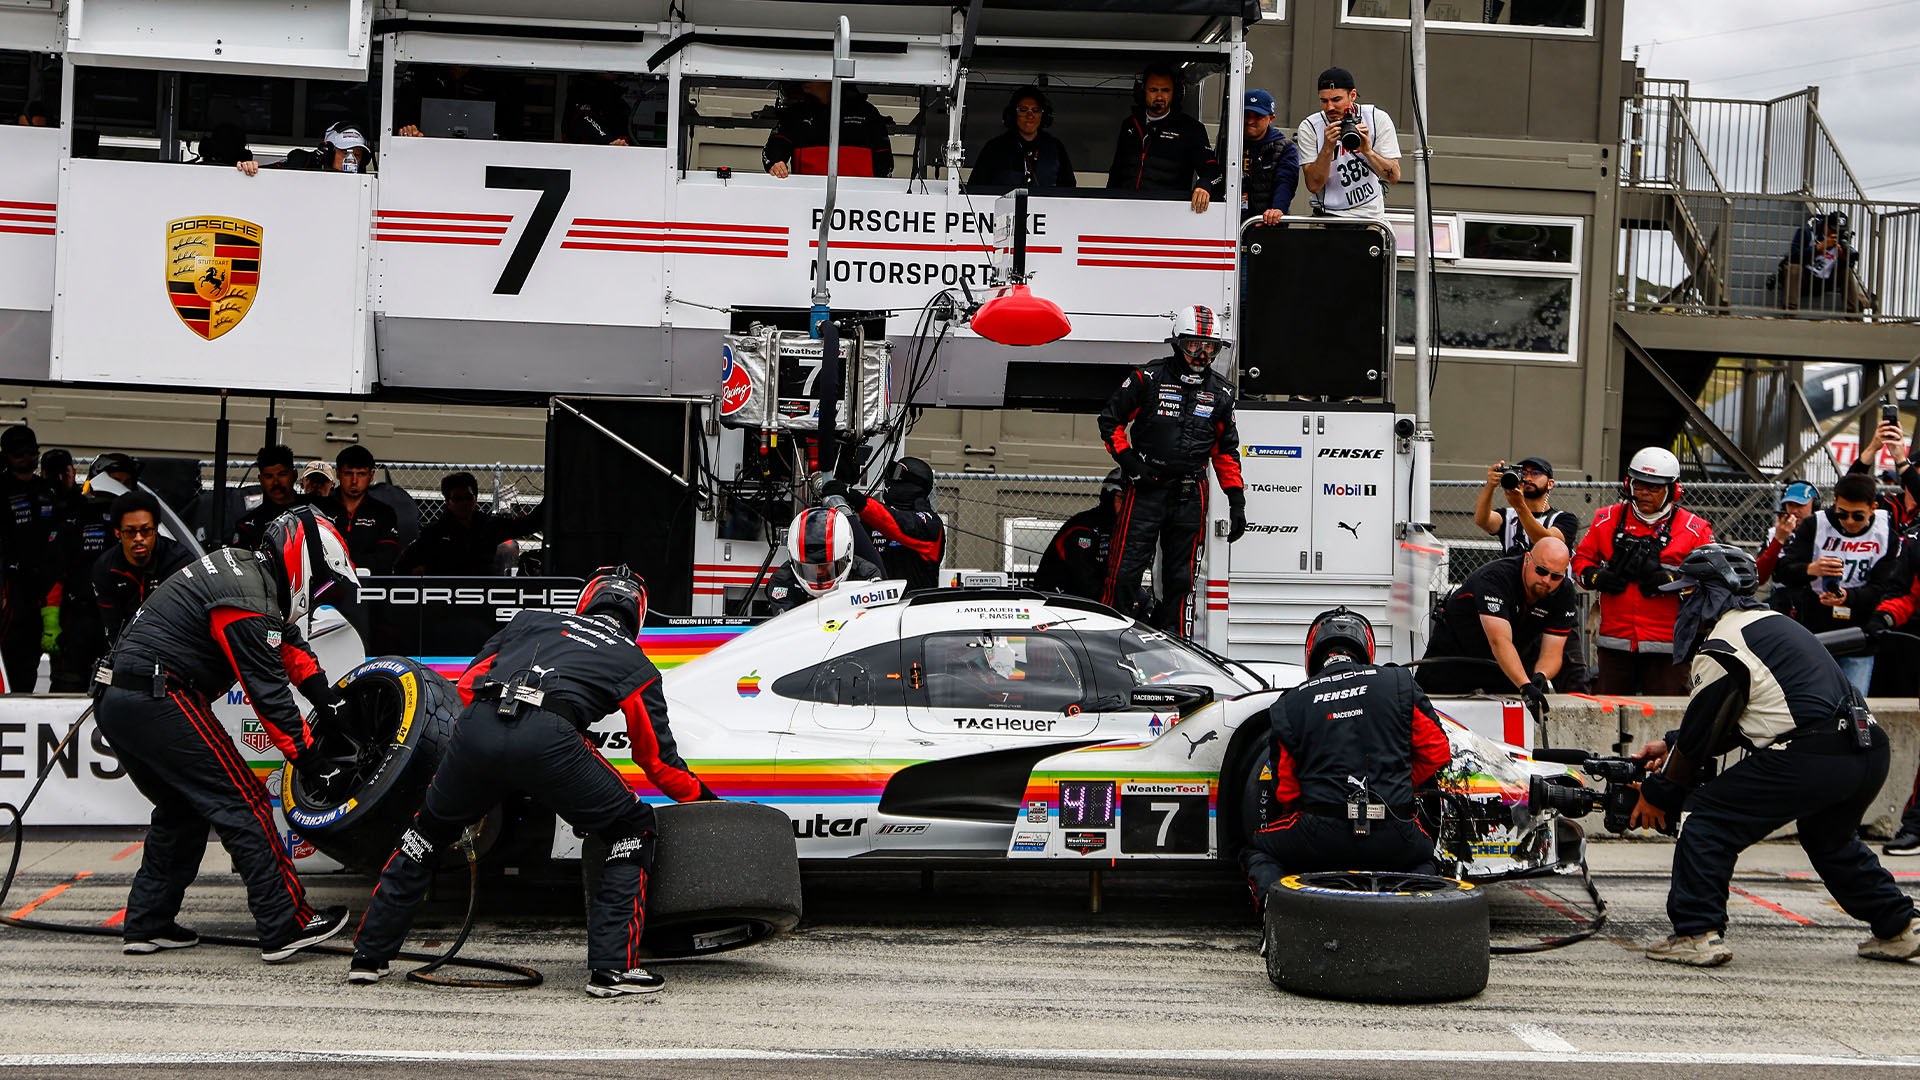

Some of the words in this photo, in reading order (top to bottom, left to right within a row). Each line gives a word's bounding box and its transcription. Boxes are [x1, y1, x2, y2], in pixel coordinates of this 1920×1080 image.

[171, 219, 258, 238] PORSCHE
[811, 208, 936, 233] PORSCHE
[485, 165, 571, 295] 7
[798, 359, 823, 396] 7
[1160, 401, 1180, 409] Ansys
[1317, 448, 1384, 459] PENSKE
[1323, 483, 1361, 496] Mobil
[1364, 485, 1376, 496] 1
[1244, 522, 1298, 534] Snap-on
[356, 588, 581, 604] PORSCHE
[850, 591, 885, 606] Mobil
[887, 588, 899, 599] 1
[357, 660, 405, 676] MICHELIN
[1298, 669, 1378, 692] PORSCHE
[1002, 692, 1009, 703] 7
[1133, 694, 1161, 702] RACEBORN
[1313, 685, 1368, 704] PENSKE
[1332, 708, 1363, 719] RACEBORN
[1127, 785, 1205, 793] WeatherTech
[291, 809, 338, 826] MICHELIN
[1151, 802, 1180, 847] 7
